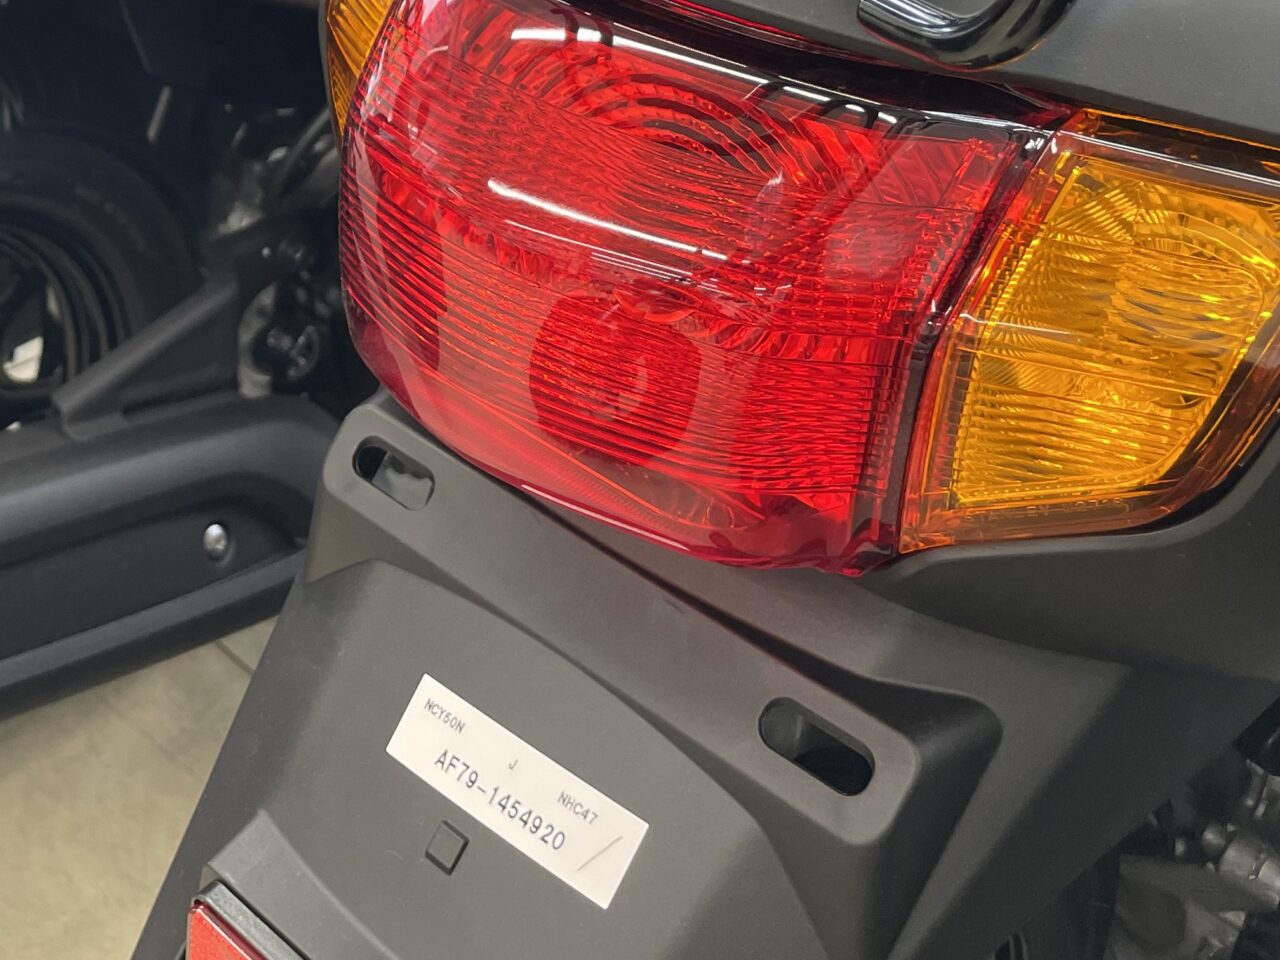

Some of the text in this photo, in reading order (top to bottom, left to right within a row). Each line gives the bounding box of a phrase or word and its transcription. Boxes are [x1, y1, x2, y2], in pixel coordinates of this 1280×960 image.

[423, 698, 599, 825] NCY50N J NHC47
[433, 748, 566, 851] AF79-1454920
